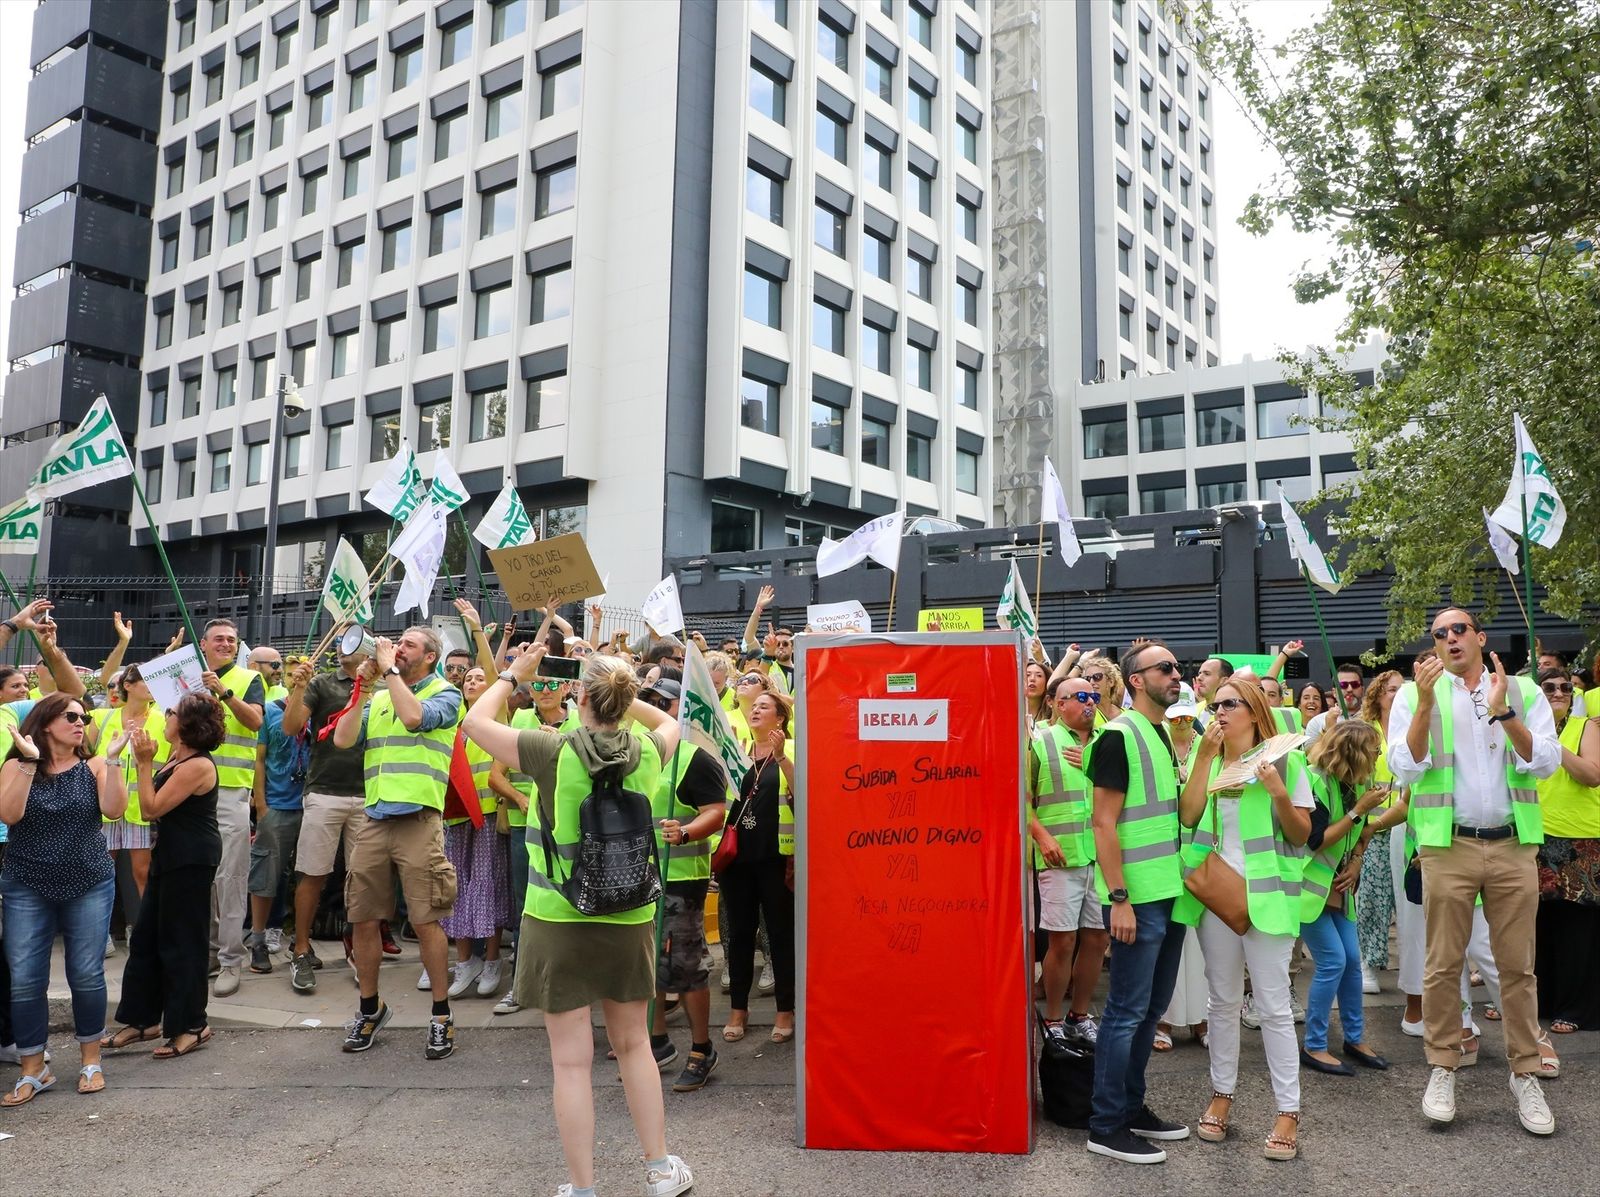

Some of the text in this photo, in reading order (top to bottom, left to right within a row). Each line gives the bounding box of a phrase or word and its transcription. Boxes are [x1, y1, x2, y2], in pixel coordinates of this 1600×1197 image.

[504, 557, 522, 572] YO
[529, 564, 562, 579] CARRO
[863, 713, 918, 726] IBERIA
[842, 757, 981, 791] SUBIDA SALARIAL
[887, 790, 917, 819] YA
[847, 826, 982, 849] CONVENIO DIGNO
[887, 853, 918, 882] YA
[856, 896, 888, 920] MESA
[888, 922, 922, 954] YA
